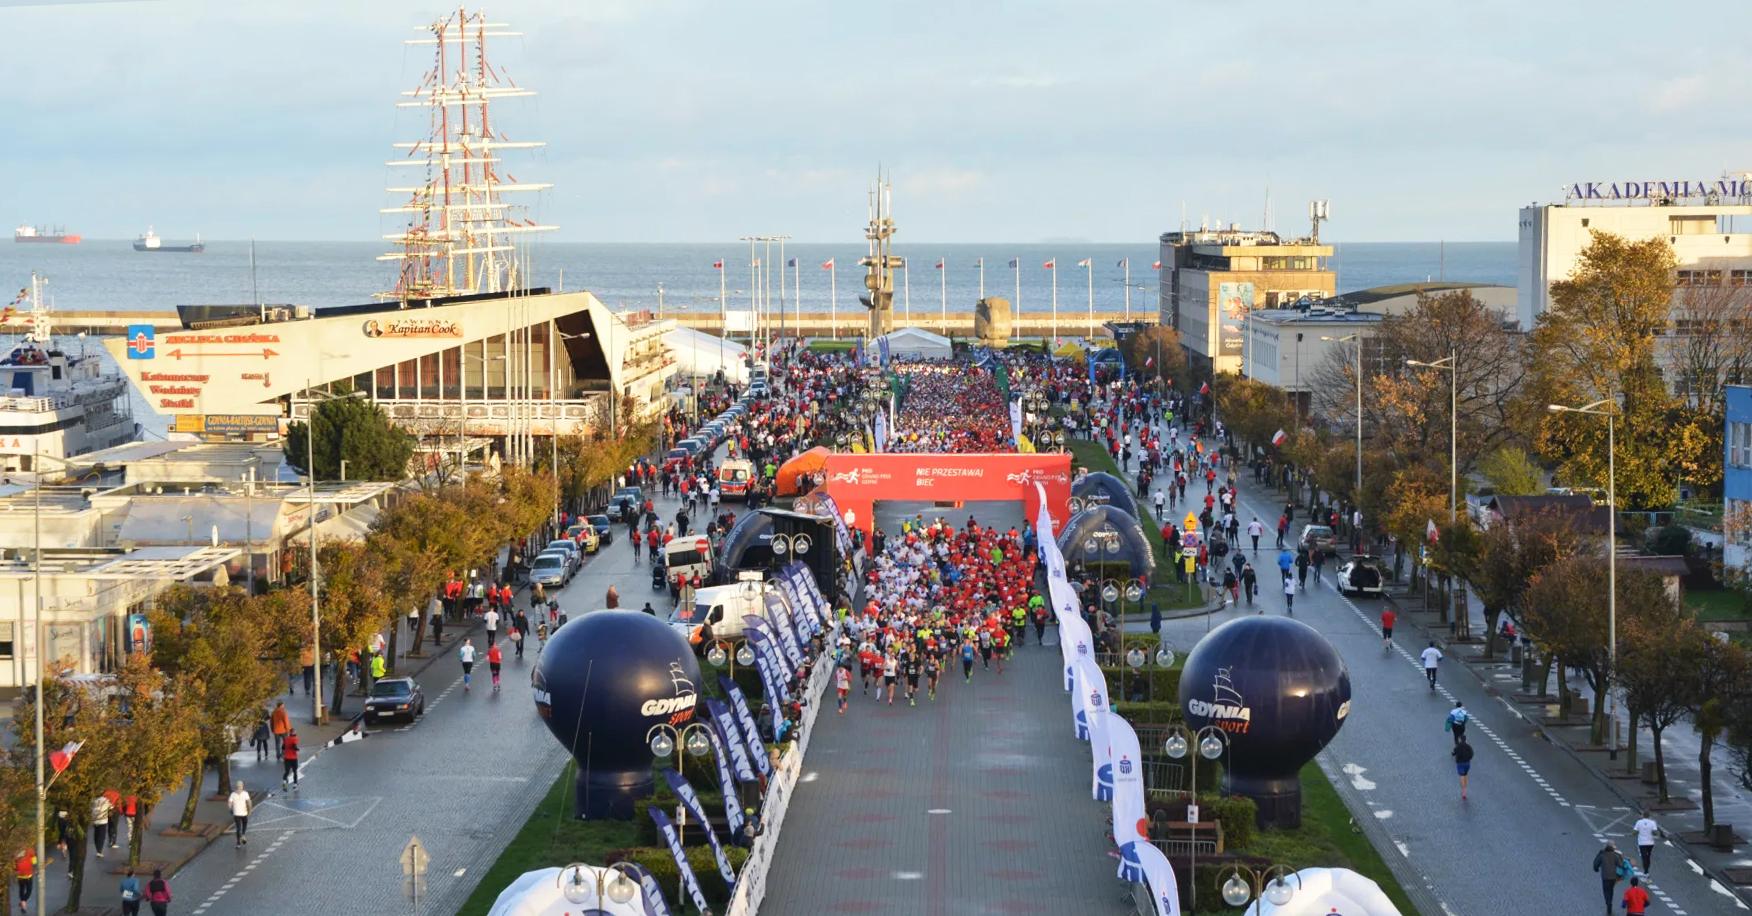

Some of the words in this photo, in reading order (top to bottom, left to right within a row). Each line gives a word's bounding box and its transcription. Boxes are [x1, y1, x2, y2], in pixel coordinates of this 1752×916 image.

[1568, 180, 1708, 199] AKADEMIA
[388, 324, 430, 336] Kapitan
[431, 323, 459, 336] Cook
[916, 467, 931, 477] NIE
[931, 467, 984, 478] PRZESTAWAJ
[916, 478, 935, 487] BIEC
[641, 693, 697, 717] GDYNIA
[1188, 698, 1250, 722] GDYNIA
[729, 687, 770, 776] GDYNIA
[1214, 719, 1250, 734] sport
